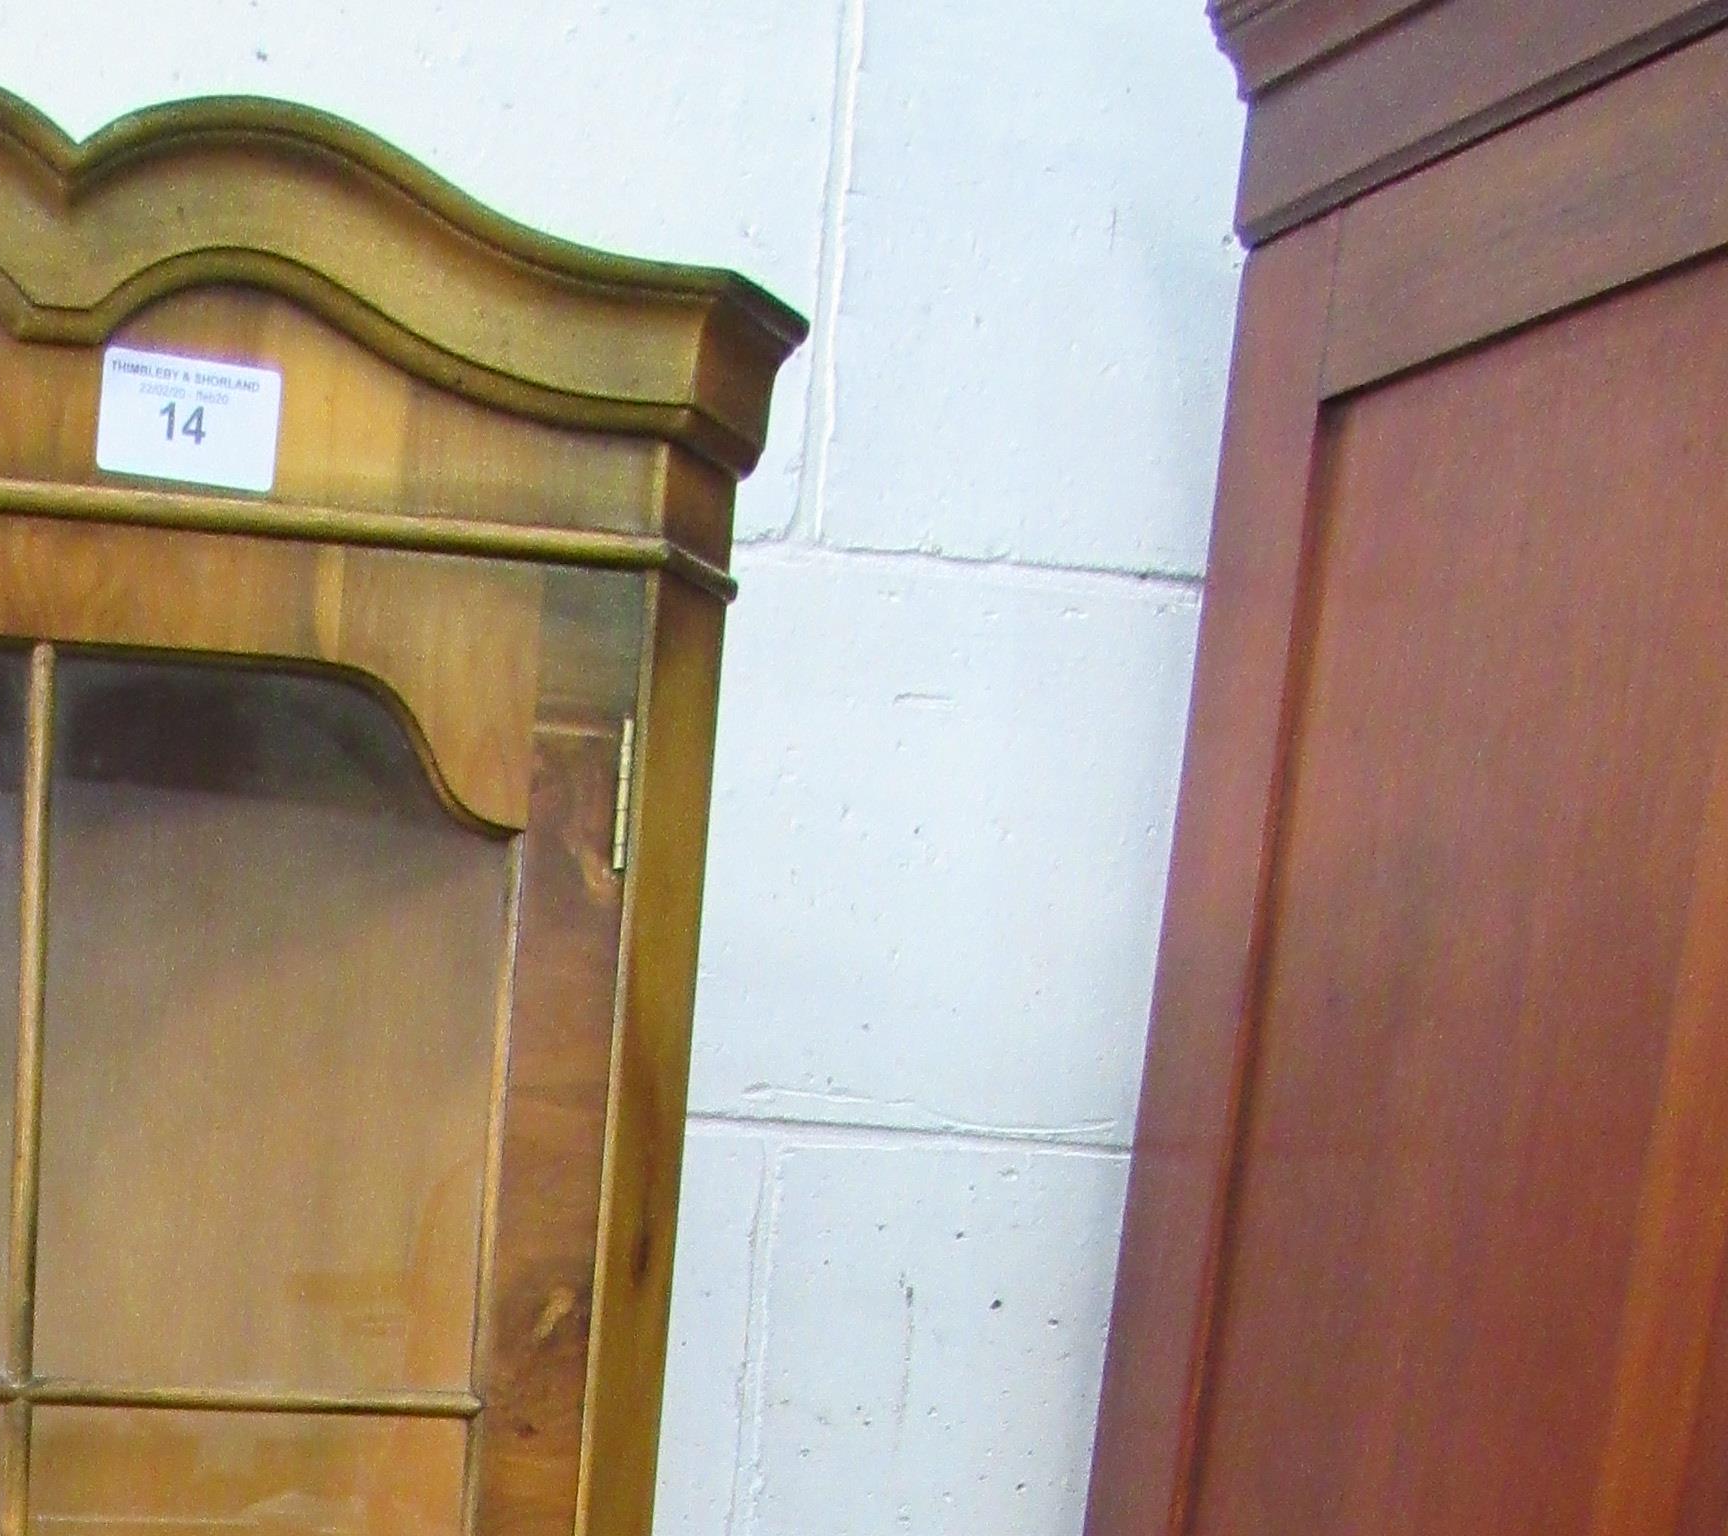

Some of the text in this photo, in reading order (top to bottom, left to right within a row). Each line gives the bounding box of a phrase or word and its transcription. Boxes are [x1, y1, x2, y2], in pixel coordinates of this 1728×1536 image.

[112, 359, 261, 393] THIMBLEBY & SHORLAND
[159, 400, 207, 445] 14
